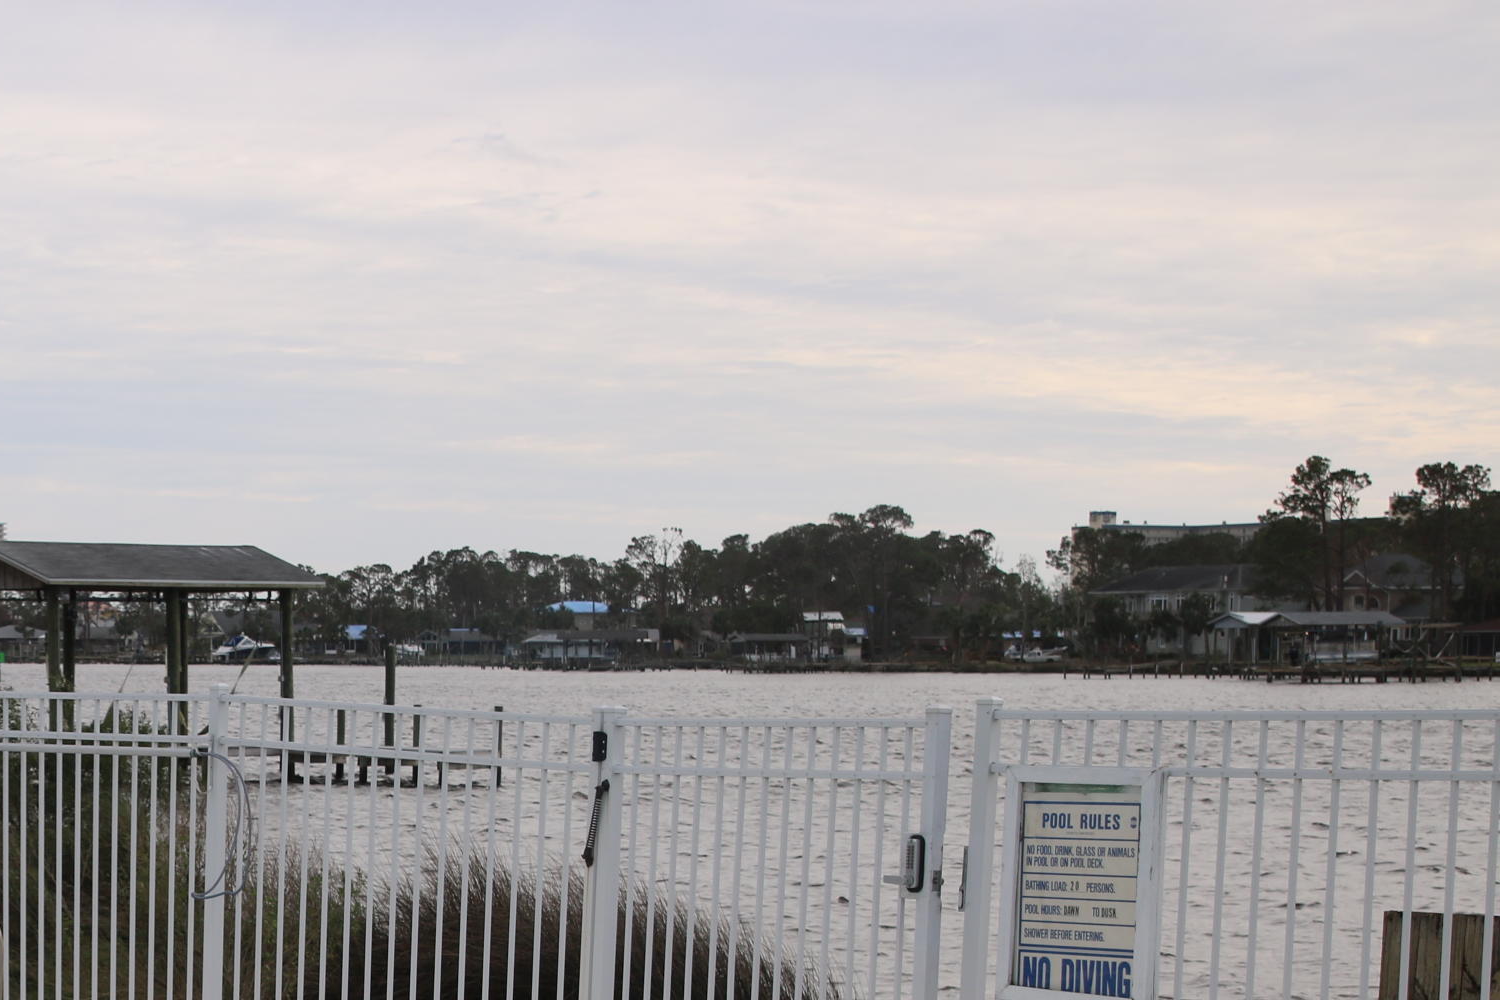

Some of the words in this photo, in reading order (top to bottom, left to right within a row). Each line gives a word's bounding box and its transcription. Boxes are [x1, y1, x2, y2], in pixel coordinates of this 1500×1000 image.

[1042, 812, 1074, 829] POOL
[1080, 813, 1121, 830] RULES
[1026, 845, 1035, 855] NO
[1075, 846, 1096, 857] GLASS
[1097, 847, 1106, 857] OR
[1107, 847, 1136, 858] ANIMALS
[1025, 856, 1033, 866] IN
[1033, 856, 1049, 867] POOL
[1050, 856, 1059, 867] OR
[1059, 857, 1069, 868] ON
[1070, 857, 1085, 868] POOL
[1025, 880, 1050, 891] BATHING
[1050, 881, 1068, 892] LOAD:
[1086, 883, 1116, 894] PERSONS.
[1024, 904, 1039, 914] POOL
[1040, 905, 1061, 916] HOURS:
[1063, 905, 1080, 916] DAWN
[1092, 907, 1100, 918] TO
[1101, 907, 1117, 918] DUSK
[1023, 928, 1049, 940] SHOWER
[1050, 929, 1073, 941] BEFORE
[1074, 930, 1105, 943] ENTERING.
[1022, 956, 1051, 990] NO
[1060, 958, 1131, 998] DIVING
